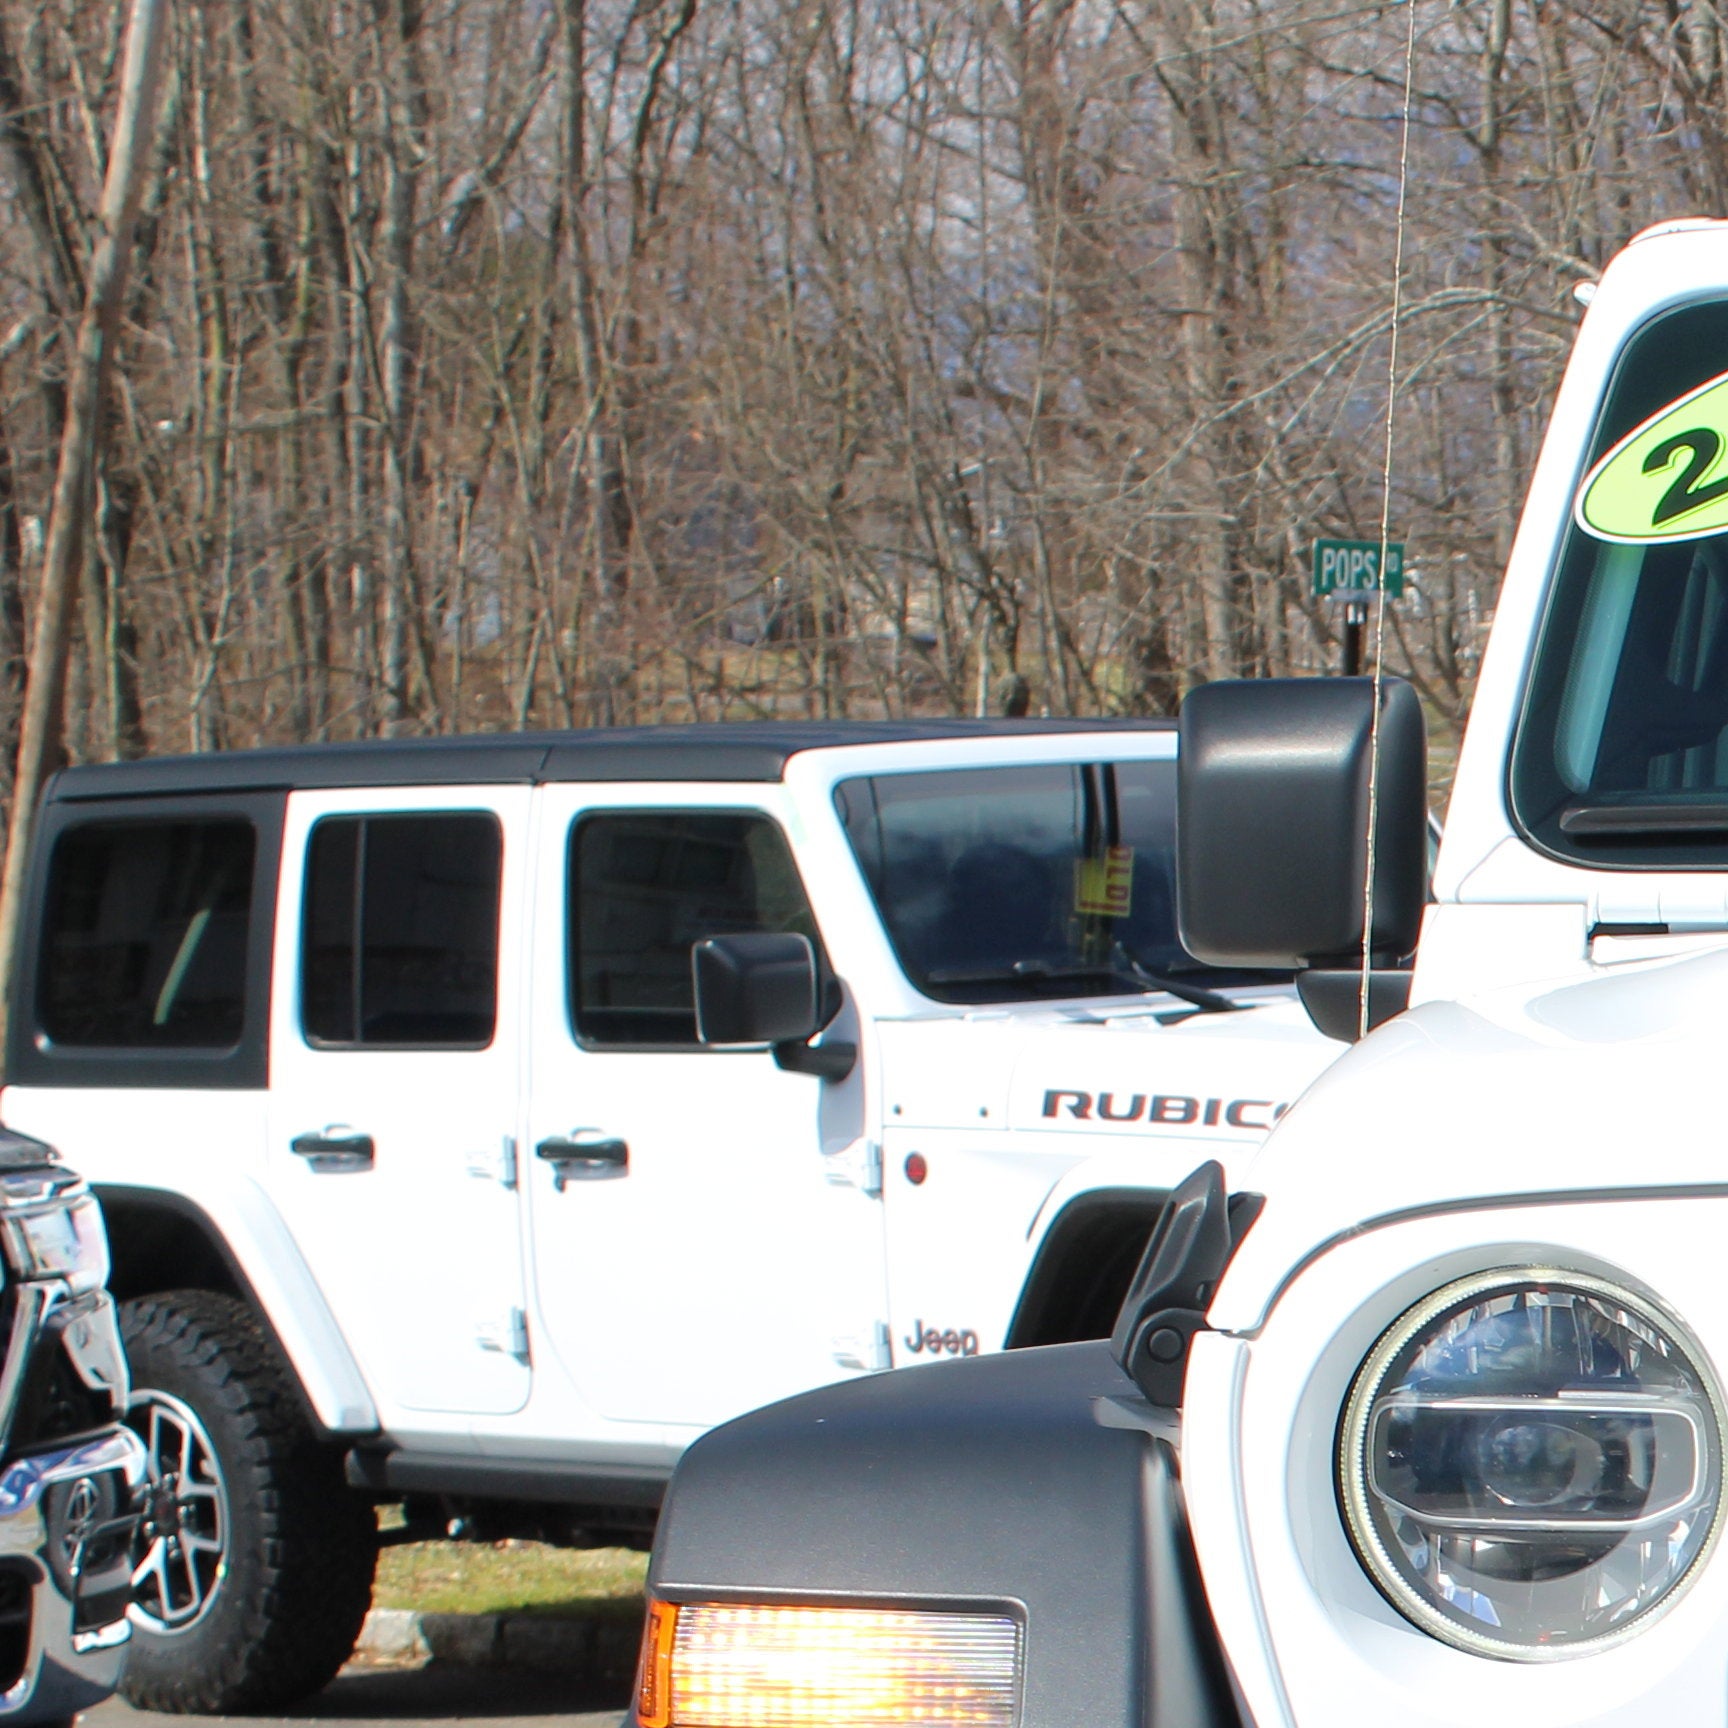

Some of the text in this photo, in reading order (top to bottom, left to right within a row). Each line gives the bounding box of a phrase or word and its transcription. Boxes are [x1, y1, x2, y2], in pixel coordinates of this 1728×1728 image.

[1321, 548, 1378, 589] POPS
[1041, 1088, 1289, 1132] RUBIC
[904, 1318, 979, 1357] Jeep
